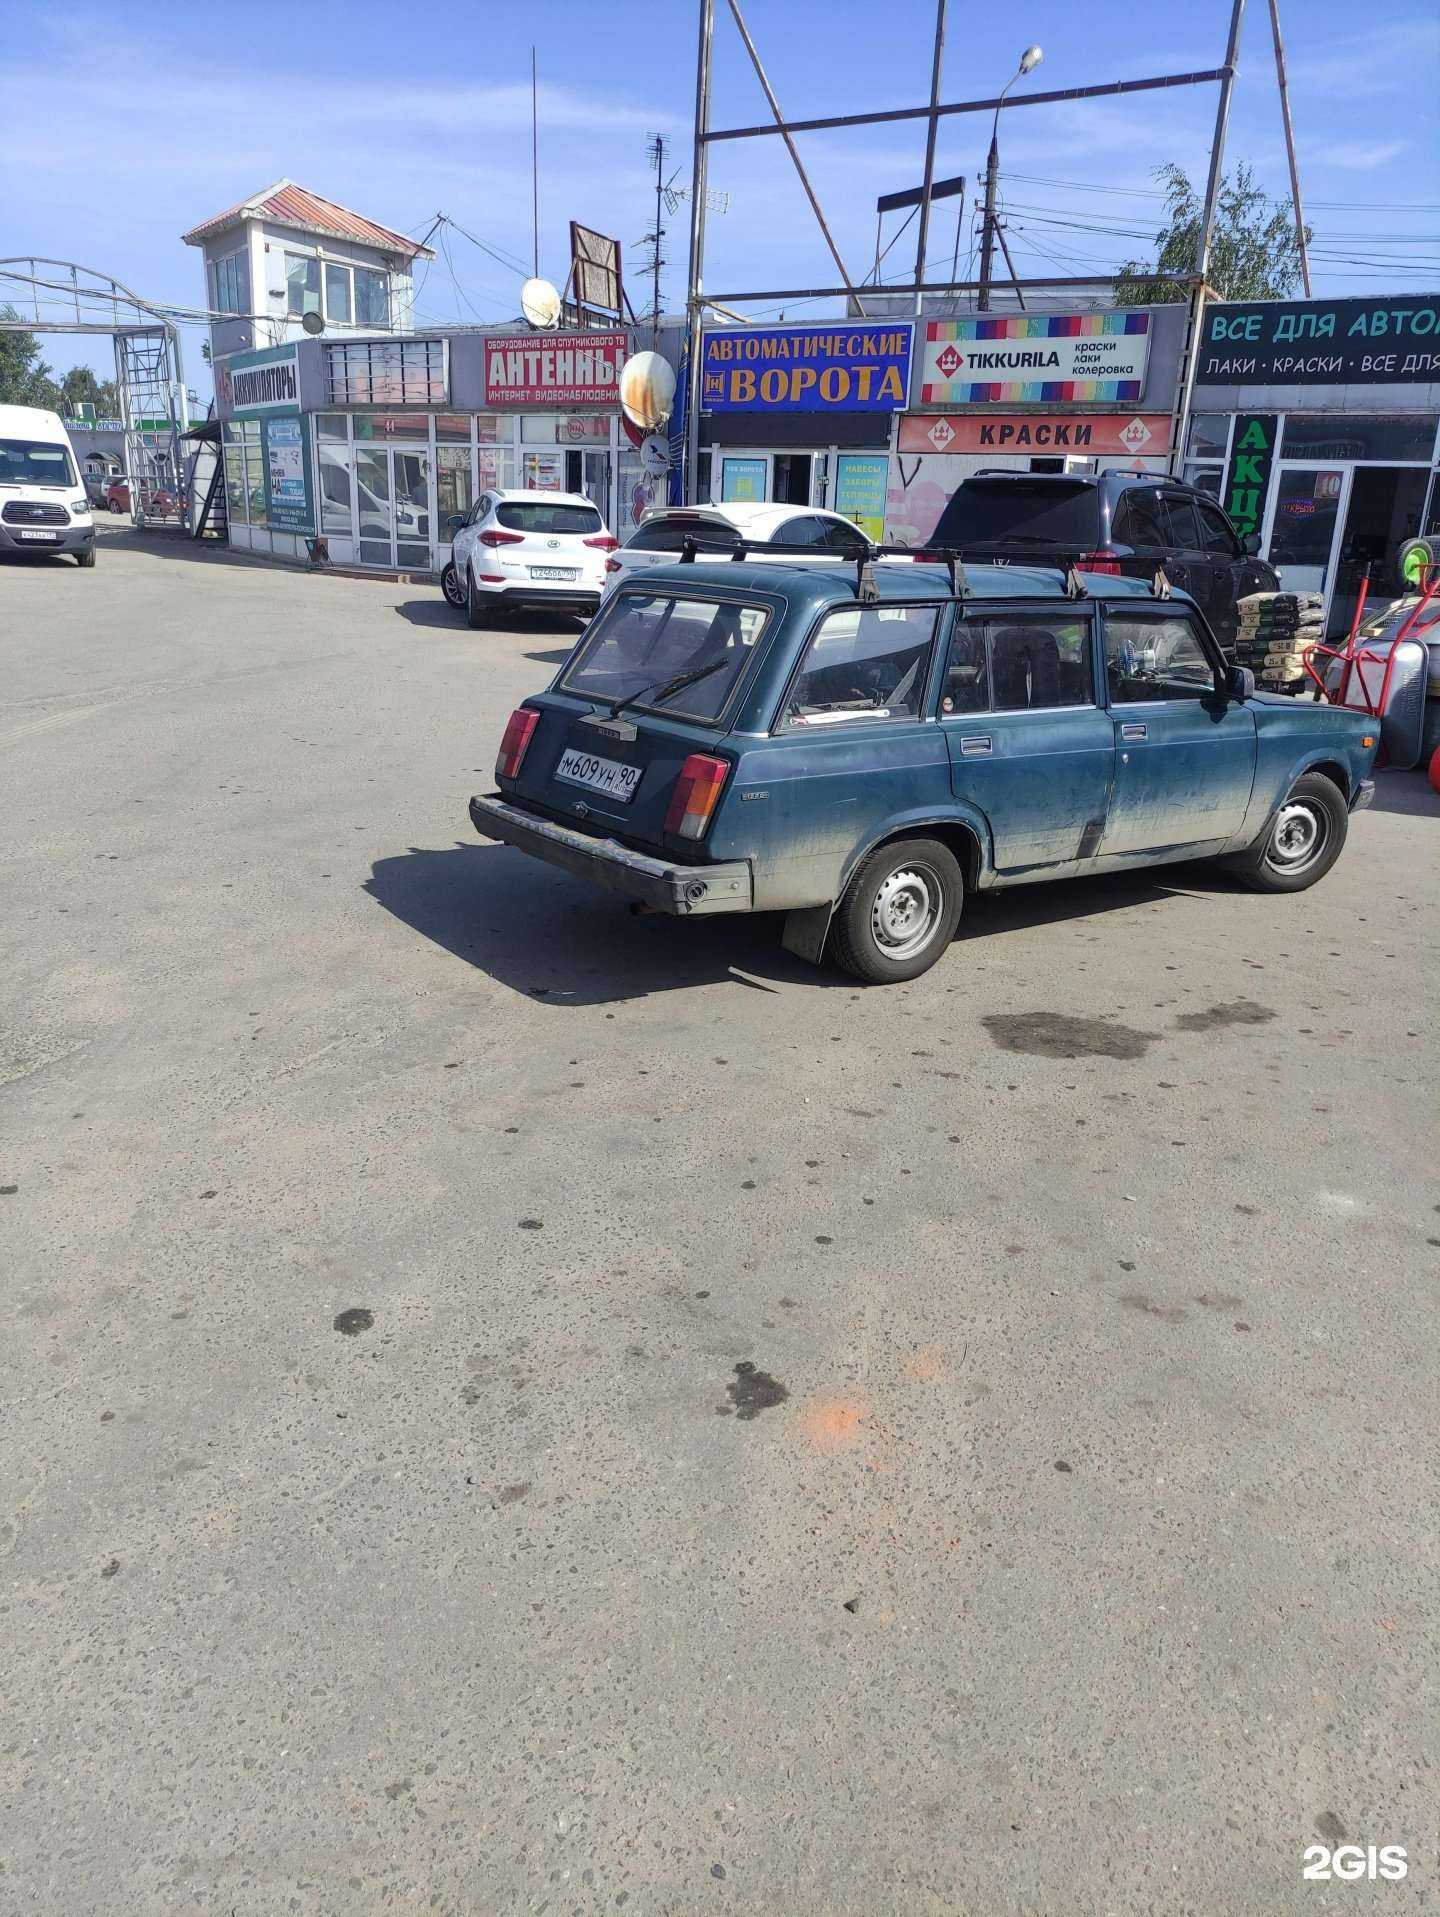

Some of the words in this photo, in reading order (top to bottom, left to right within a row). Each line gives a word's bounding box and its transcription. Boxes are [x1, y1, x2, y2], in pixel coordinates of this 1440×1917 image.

[1211, 315, 1264, 341] ВСЕ
[1272, 313, 1337, 343] ДЛЯ
[1347, 309, 1440, 337] АВТО
[488, 339, 540, 350] ОБОРУДОВАНИЕ
[542, 338, 556, 349] ДЛЯ
[557, 336, 613, 348] СПУТНИКОВОГО
[615, 336, 625, 346] ТВ
[708, 333, 908, 360] АВТОМАТИЧЕСКИЕ
[1075, 342, 1117, 352] краски
[489, 348, 625, 387] АНТЕННЫ
[967, 351, 1060, 369] TIKKURILA
[1073, 354, 1101, 363] лаки
[1206, 357, 1256, 374] ЛАКИ
[1273, 356, 1343, 373] КРАСКИ
[1361, 354, 1398, 372] ВСЕ
[1401, 354, 1440, 374] ДЛЯ
[1072, 365, 1133, 377] колеровка
[233, 364, 297, 407] АККУМУЛЯТОРЫ
[730, 366, 905, 403] ВОРОТА
[488, 390, 531, 401] ИНТЕРНЕТ
[535, 389, 622, 401] ВИДЕОНАБЛЮДЕНИ
[980, 424, 1092, 445] КРАСКИ
[619, 767, 635, 787] 90
